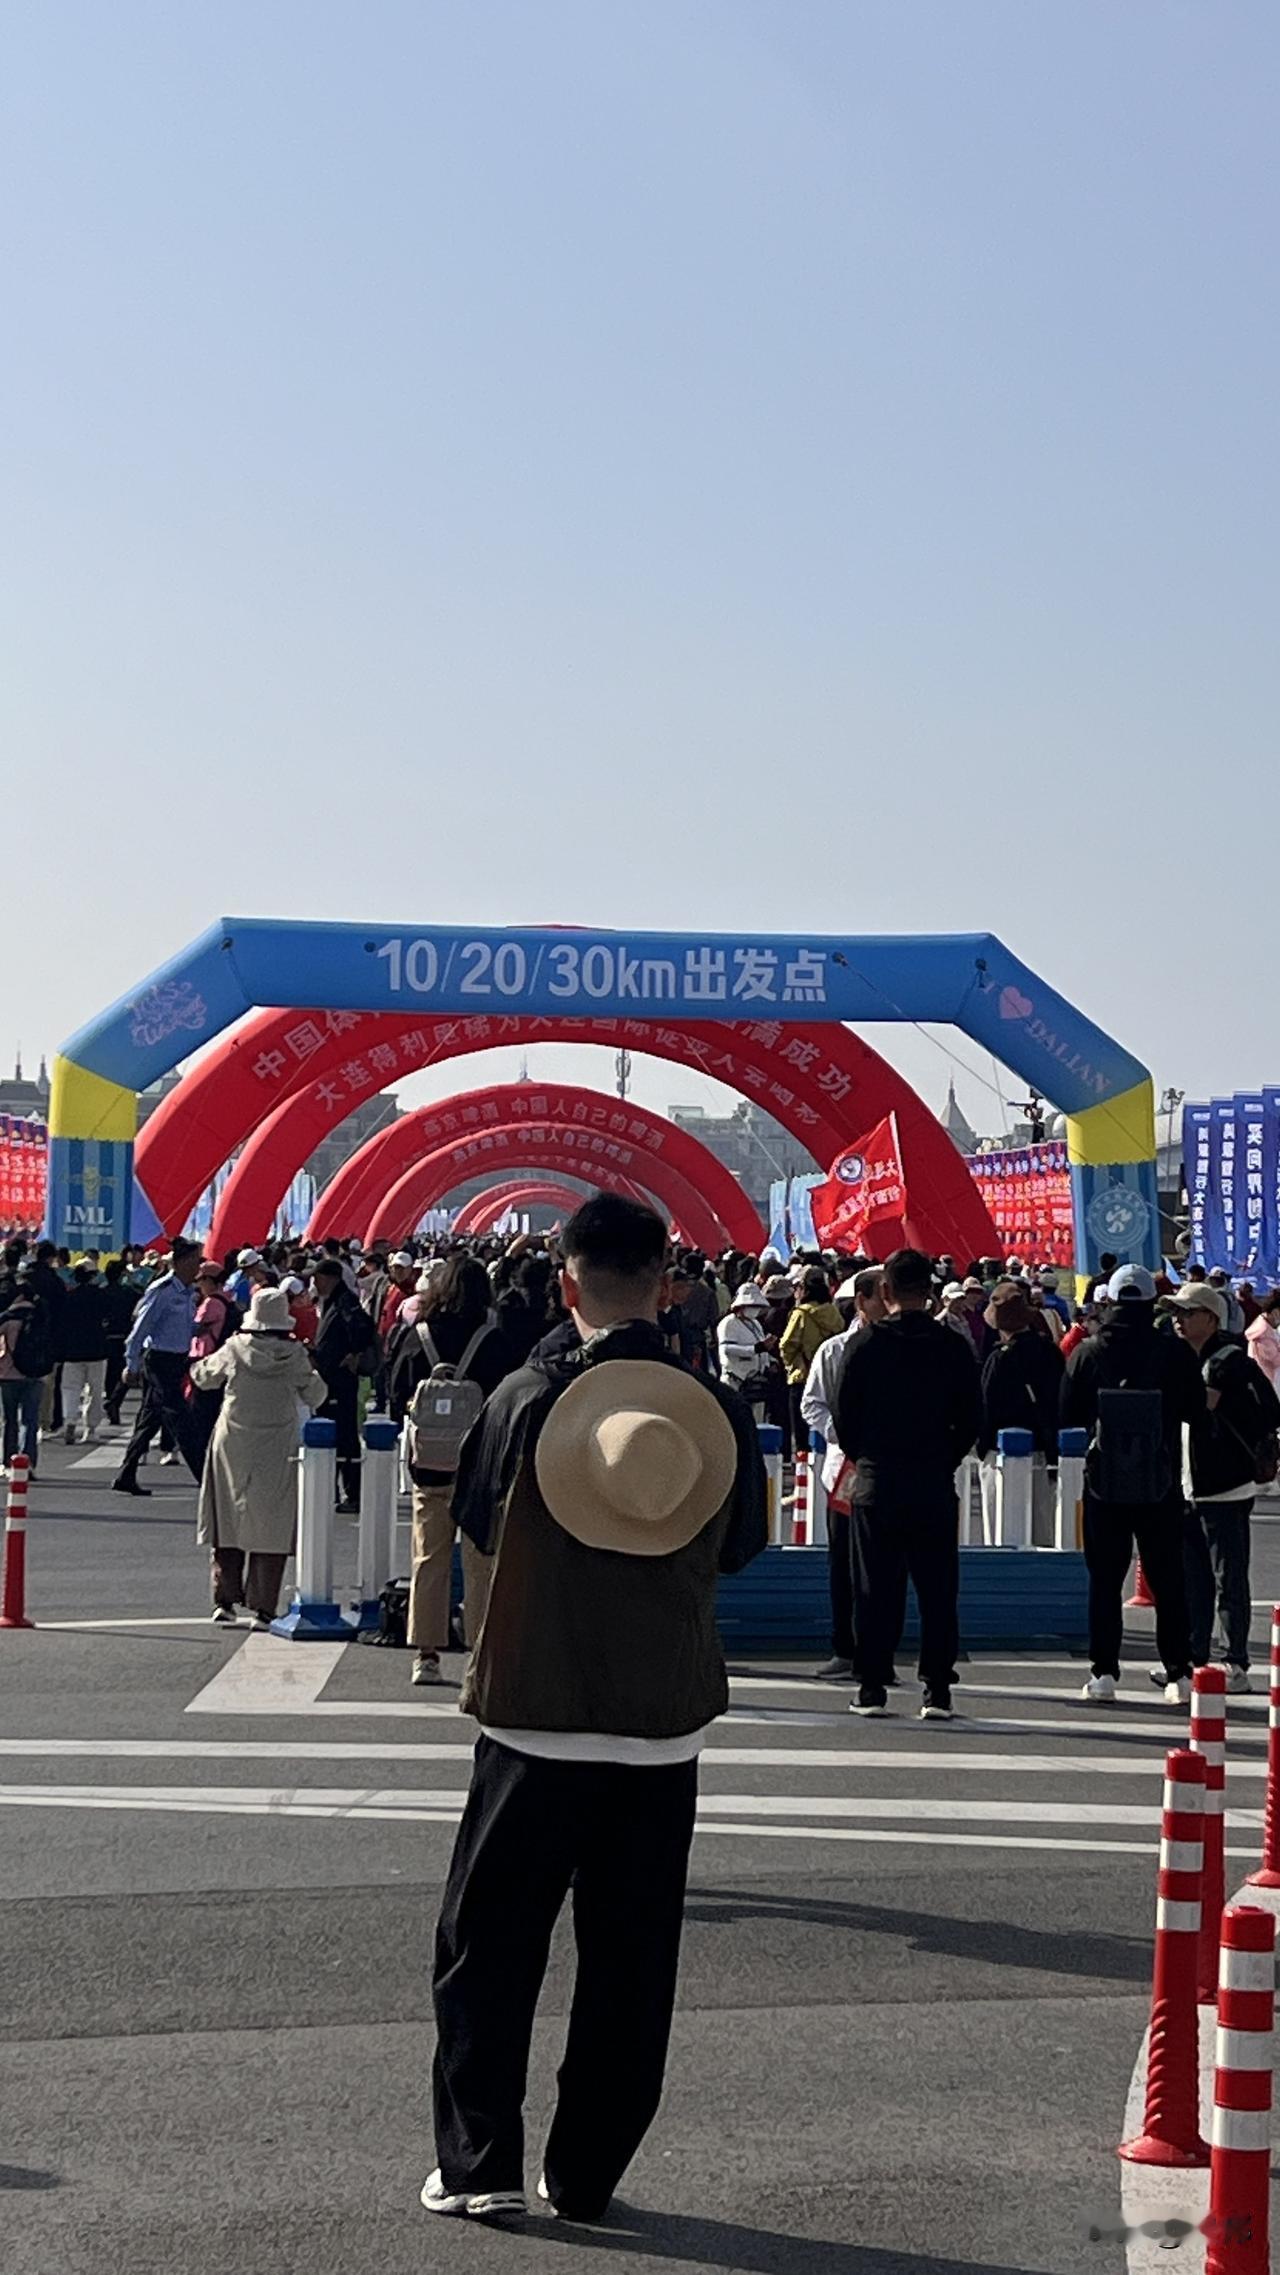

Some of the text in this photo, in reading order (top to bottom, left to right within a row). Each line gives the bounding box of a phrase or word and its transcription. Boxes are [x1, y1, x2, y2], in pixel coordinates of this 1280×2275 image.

[376, 939, 827, 1002] 10/20/30km出发点
[1025, 1018, 1112, 1093] DALIAN
[64, 1204, 114, 1225] IML
